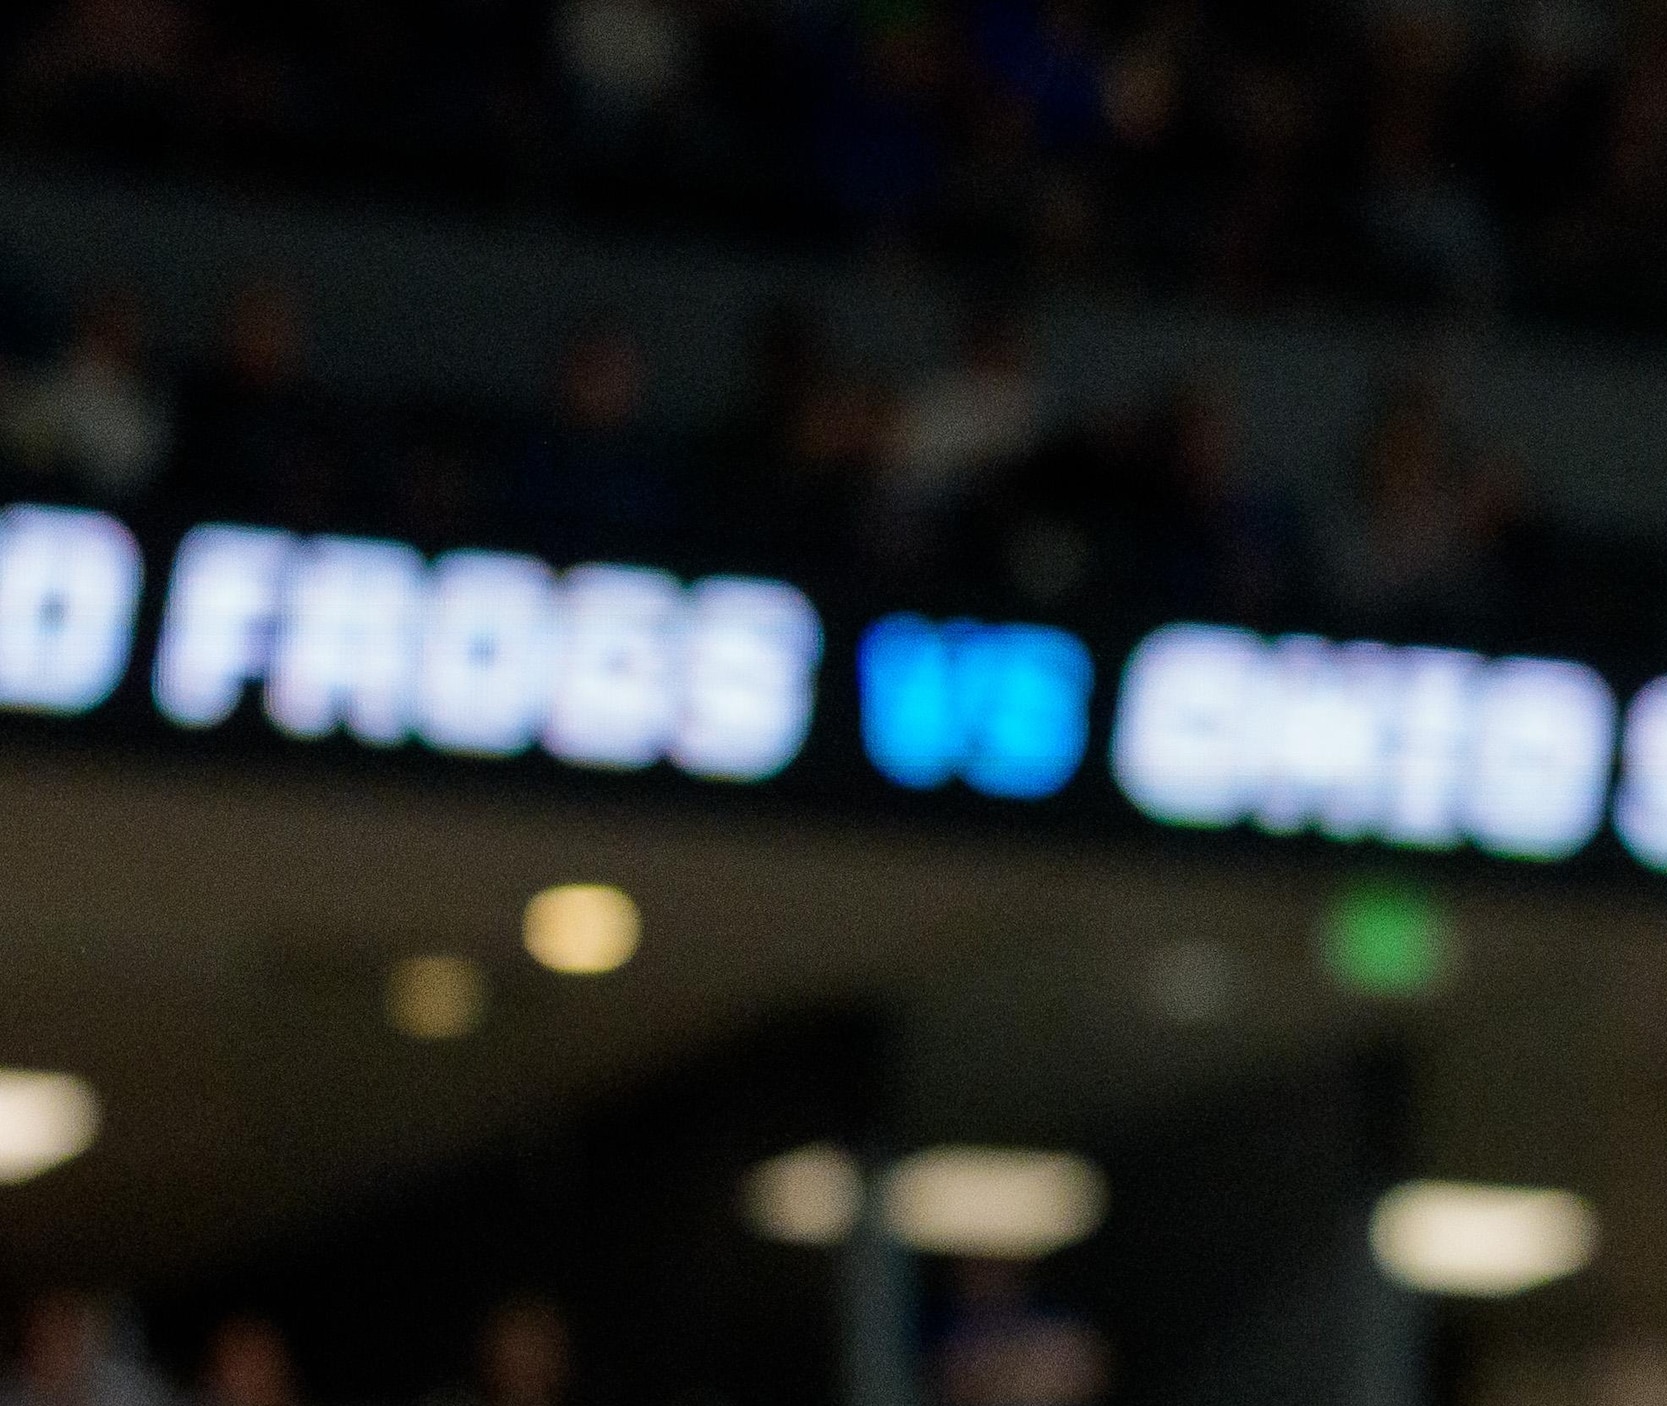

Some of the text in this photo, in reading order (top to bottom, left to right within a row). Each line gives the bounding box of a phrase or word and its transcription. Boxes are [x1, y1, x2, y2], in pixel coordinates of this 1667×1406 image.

[154, 525, 822, 780] FROGS
[858, 614, 1091, 797] VS
[1112, 624, 1614, 860] OHIO
